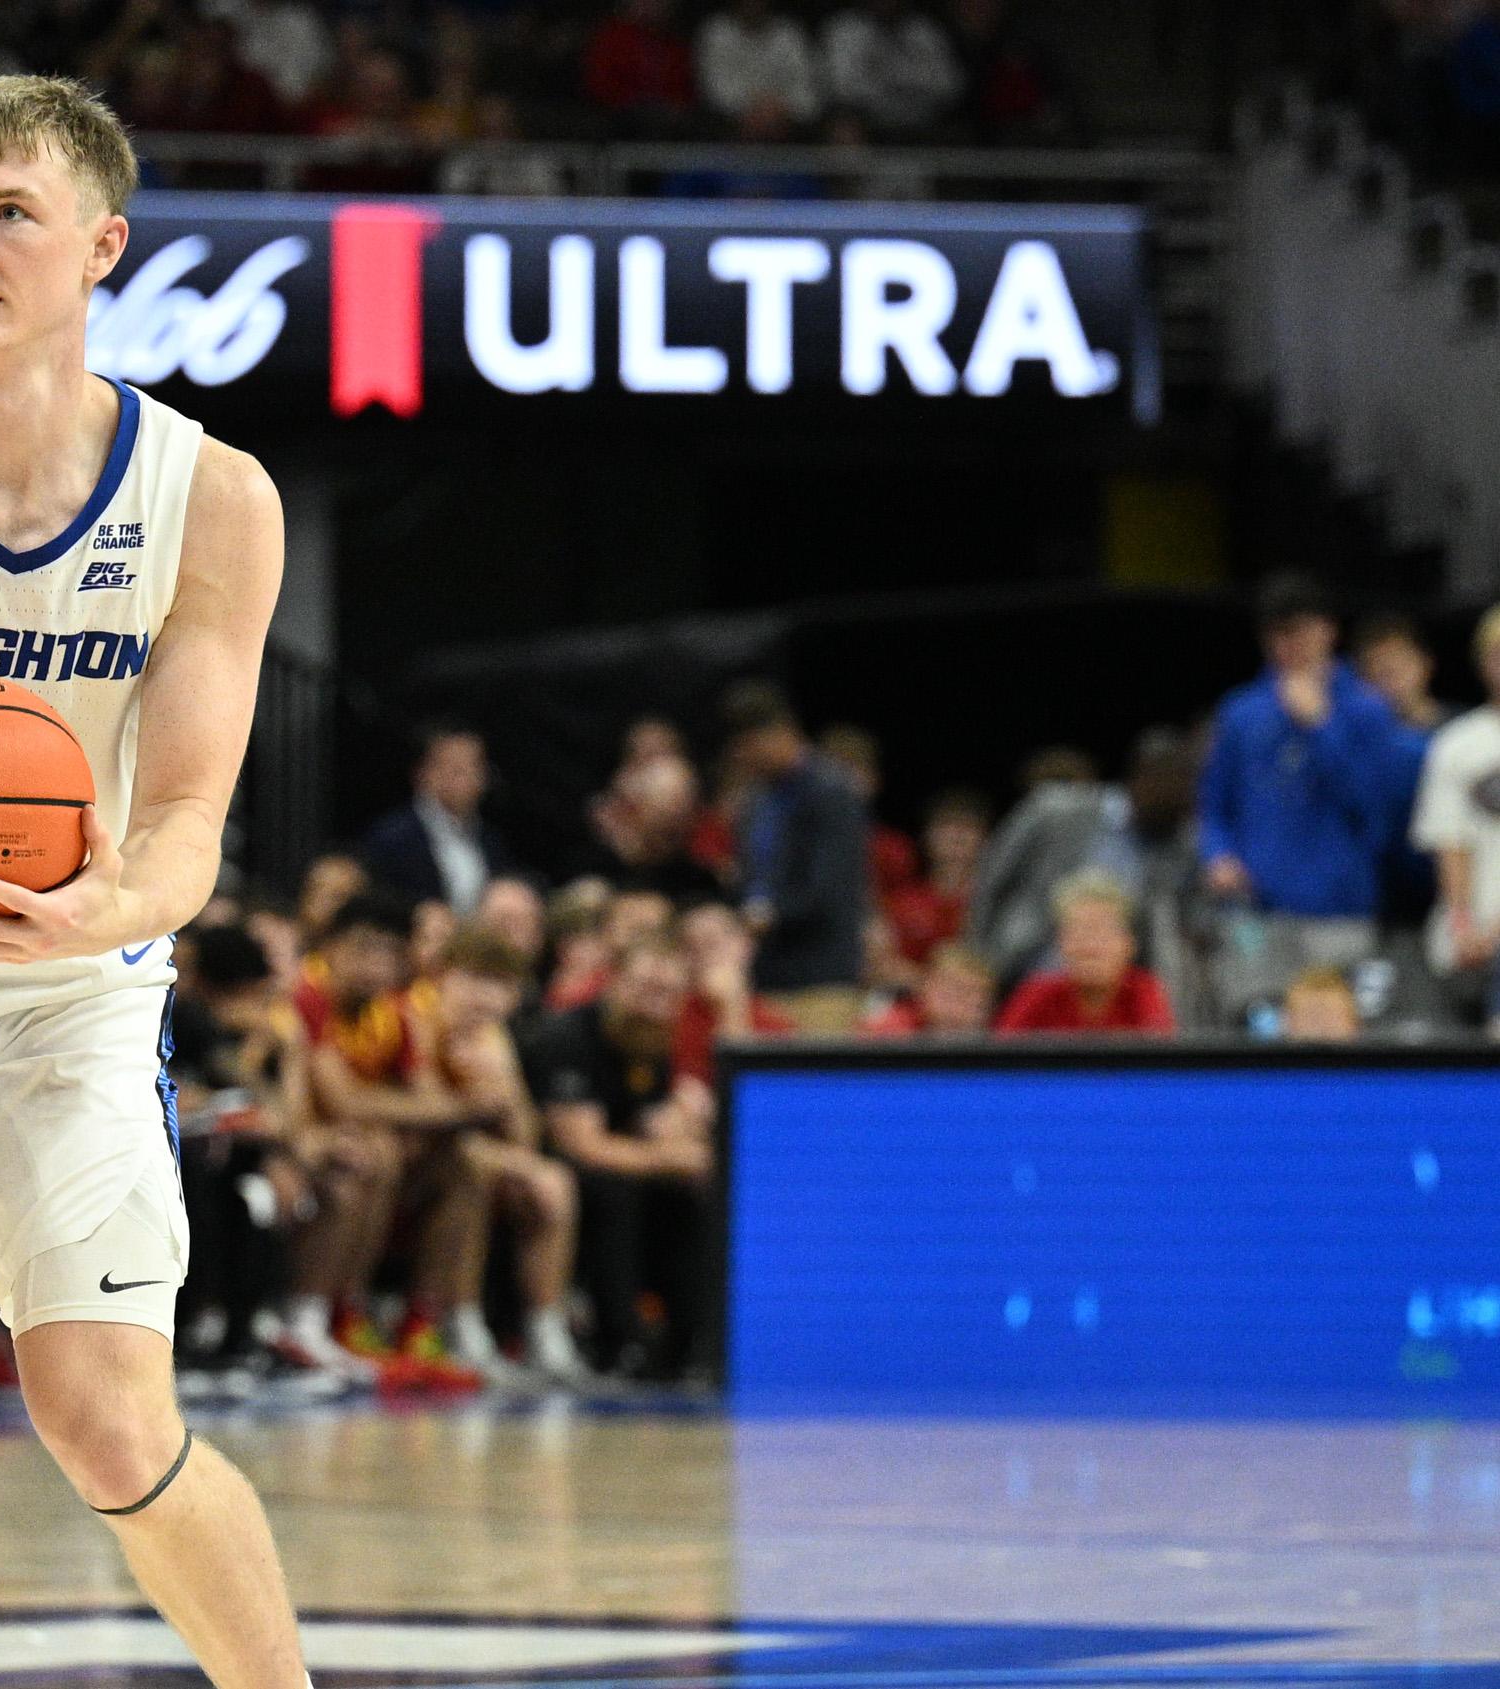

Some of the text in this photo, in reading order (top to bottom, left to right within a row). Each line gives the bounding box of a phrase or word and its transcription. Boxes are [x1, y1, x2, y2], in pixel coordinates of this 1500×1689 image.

[97, 522, 143, 537] BE THE
[92, 535, 146, 550] CHANGE
[86, 561, 127, 574] BIG
[80, 573, 137, 585] EAST
